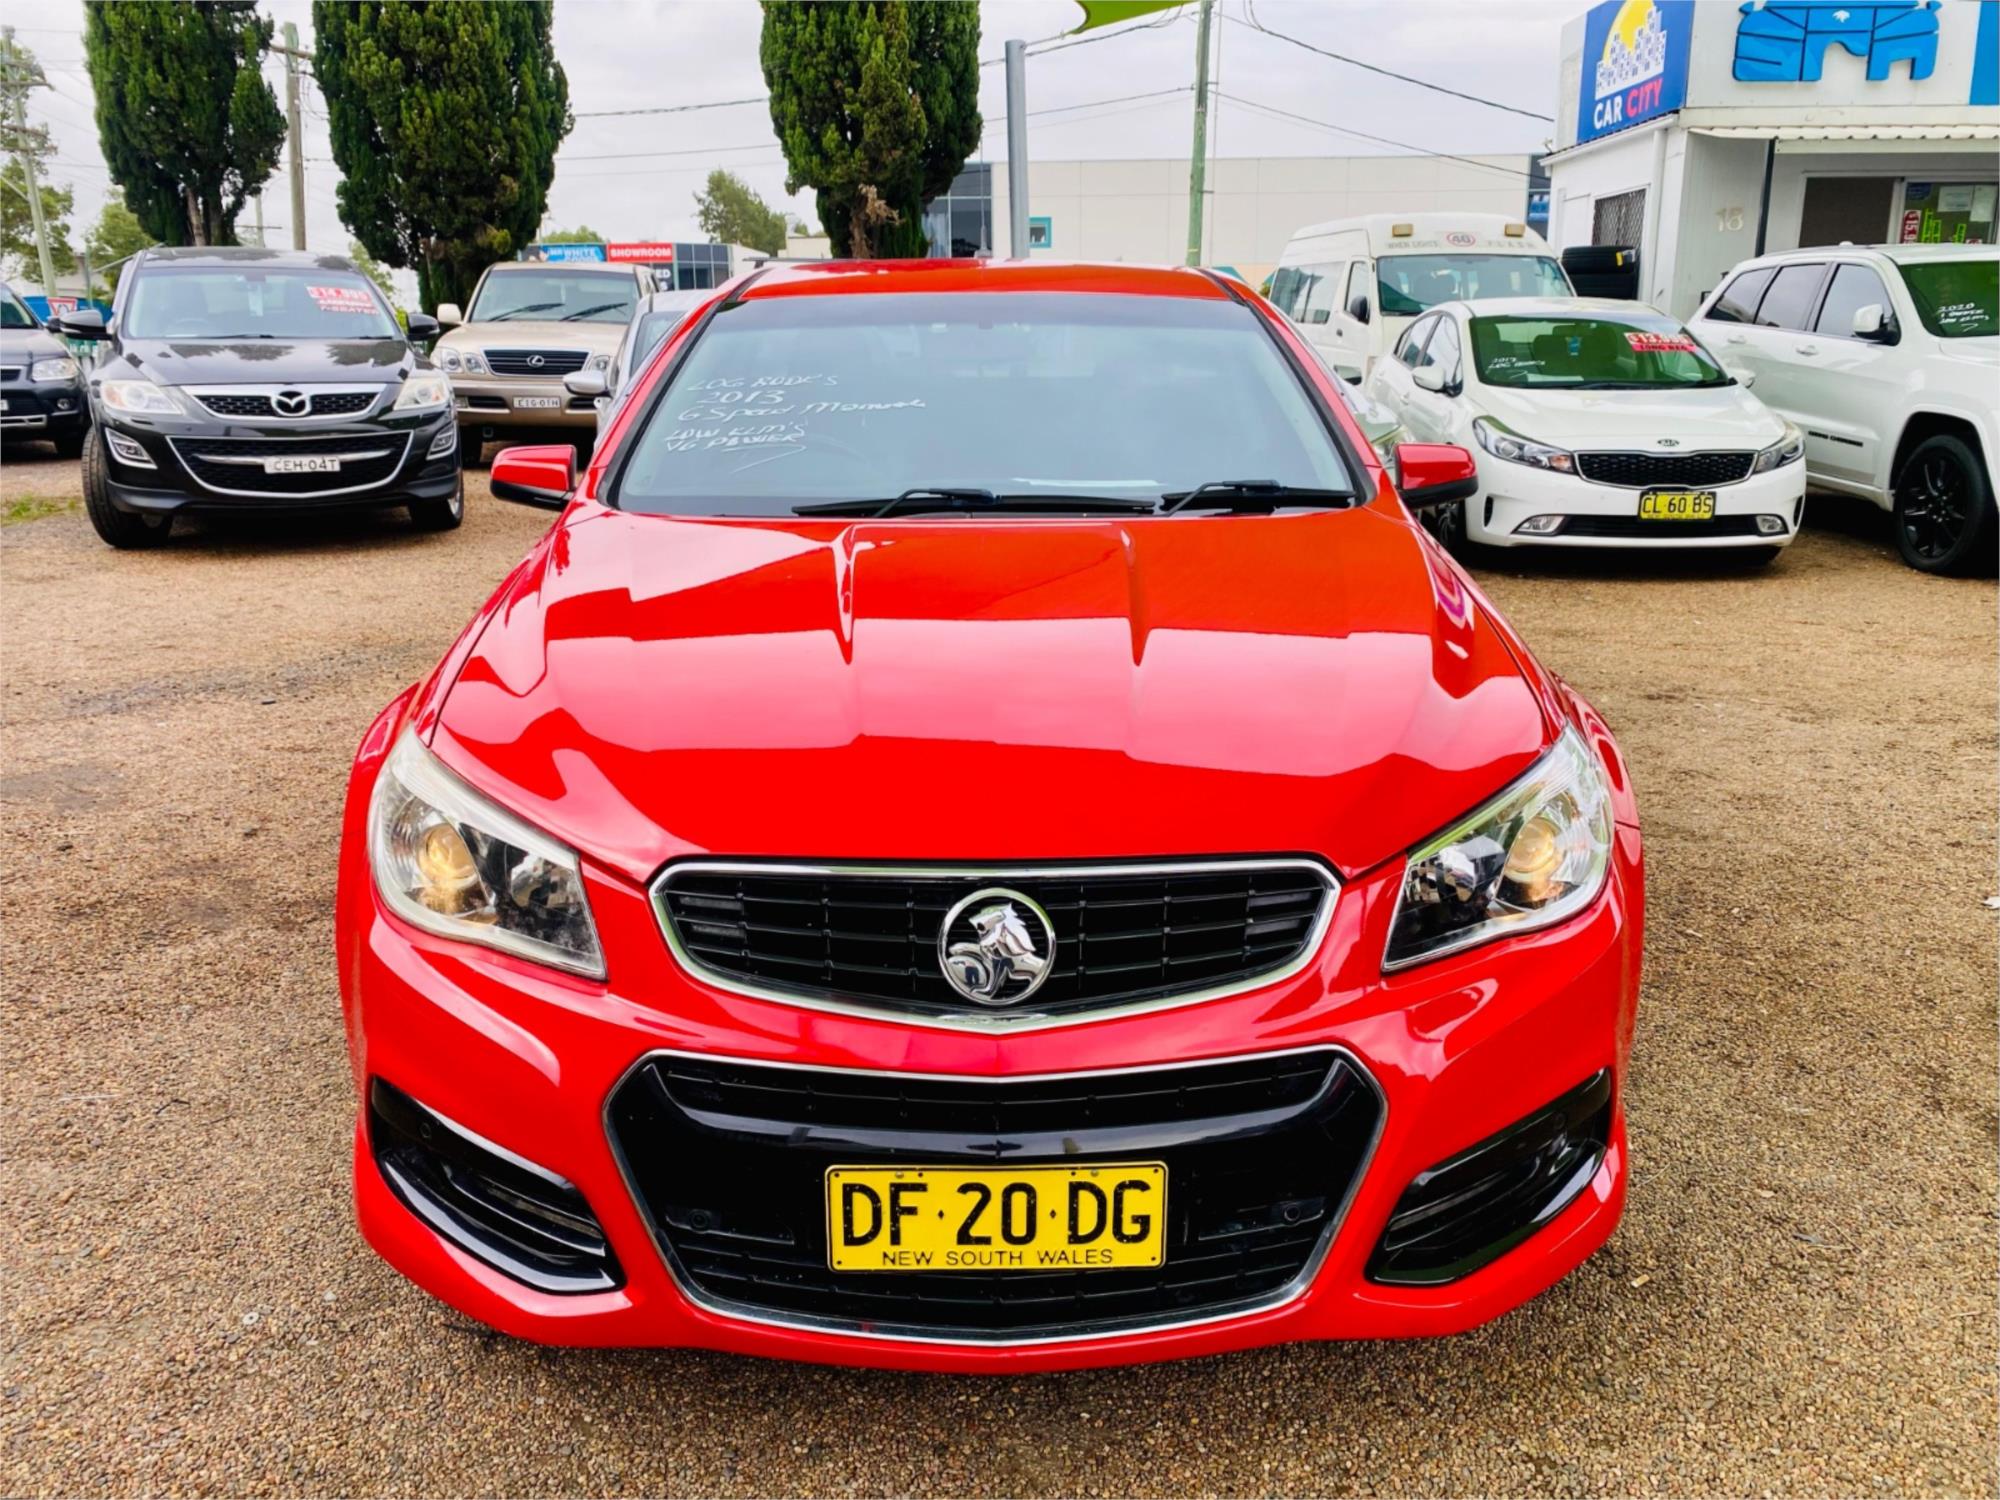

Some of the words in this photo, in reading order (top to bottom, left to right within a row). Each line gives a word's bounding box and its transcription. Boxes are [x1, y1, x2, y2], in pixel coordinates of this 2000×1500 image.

[1594, 95, 1622, 130] CAR
[1626, 77, 1663, 118] CITY
[610, 248, 672, 258] SHOWROOM
[687, 377, 745, 391] LOG
[696, 390, 785, 404] 2013
[1642, 497, 1662, 514] CL
[1667, 497, 1687, 513] 60
[1692, 496, 1713, 513] BS
[882, 1251, 932, 1266] NEW
[945, 1251, 1023, 1266] SOUTH
[1037, 1250, 1113, 1265] WALES
